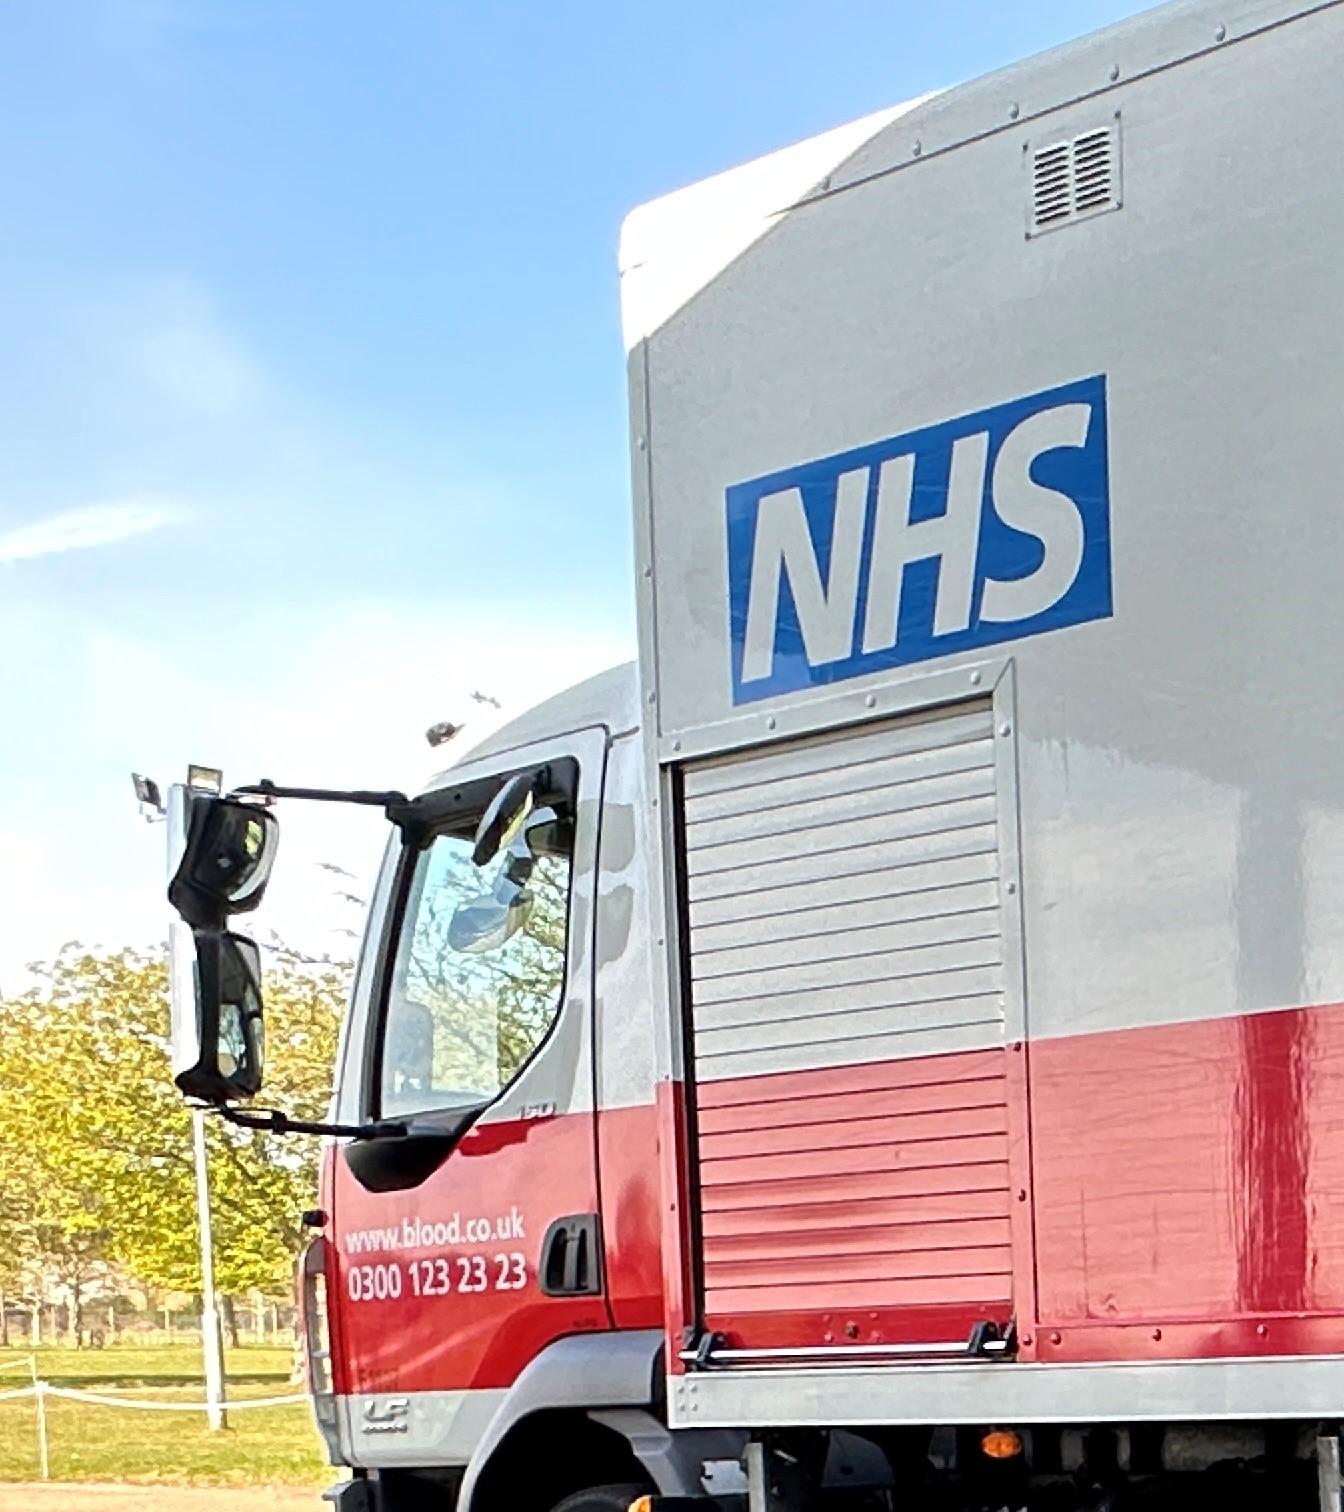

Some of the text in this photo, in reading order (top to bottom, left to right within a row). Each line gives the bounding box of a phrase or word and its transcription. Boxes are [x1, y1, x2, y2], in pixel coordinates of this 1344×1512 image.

[741, 402, 1092, 683] NHS
[345, 1206, 526, 1253] www.blood.co.uk
[349, 1252, 527, 1301] 0300 123 23 23
